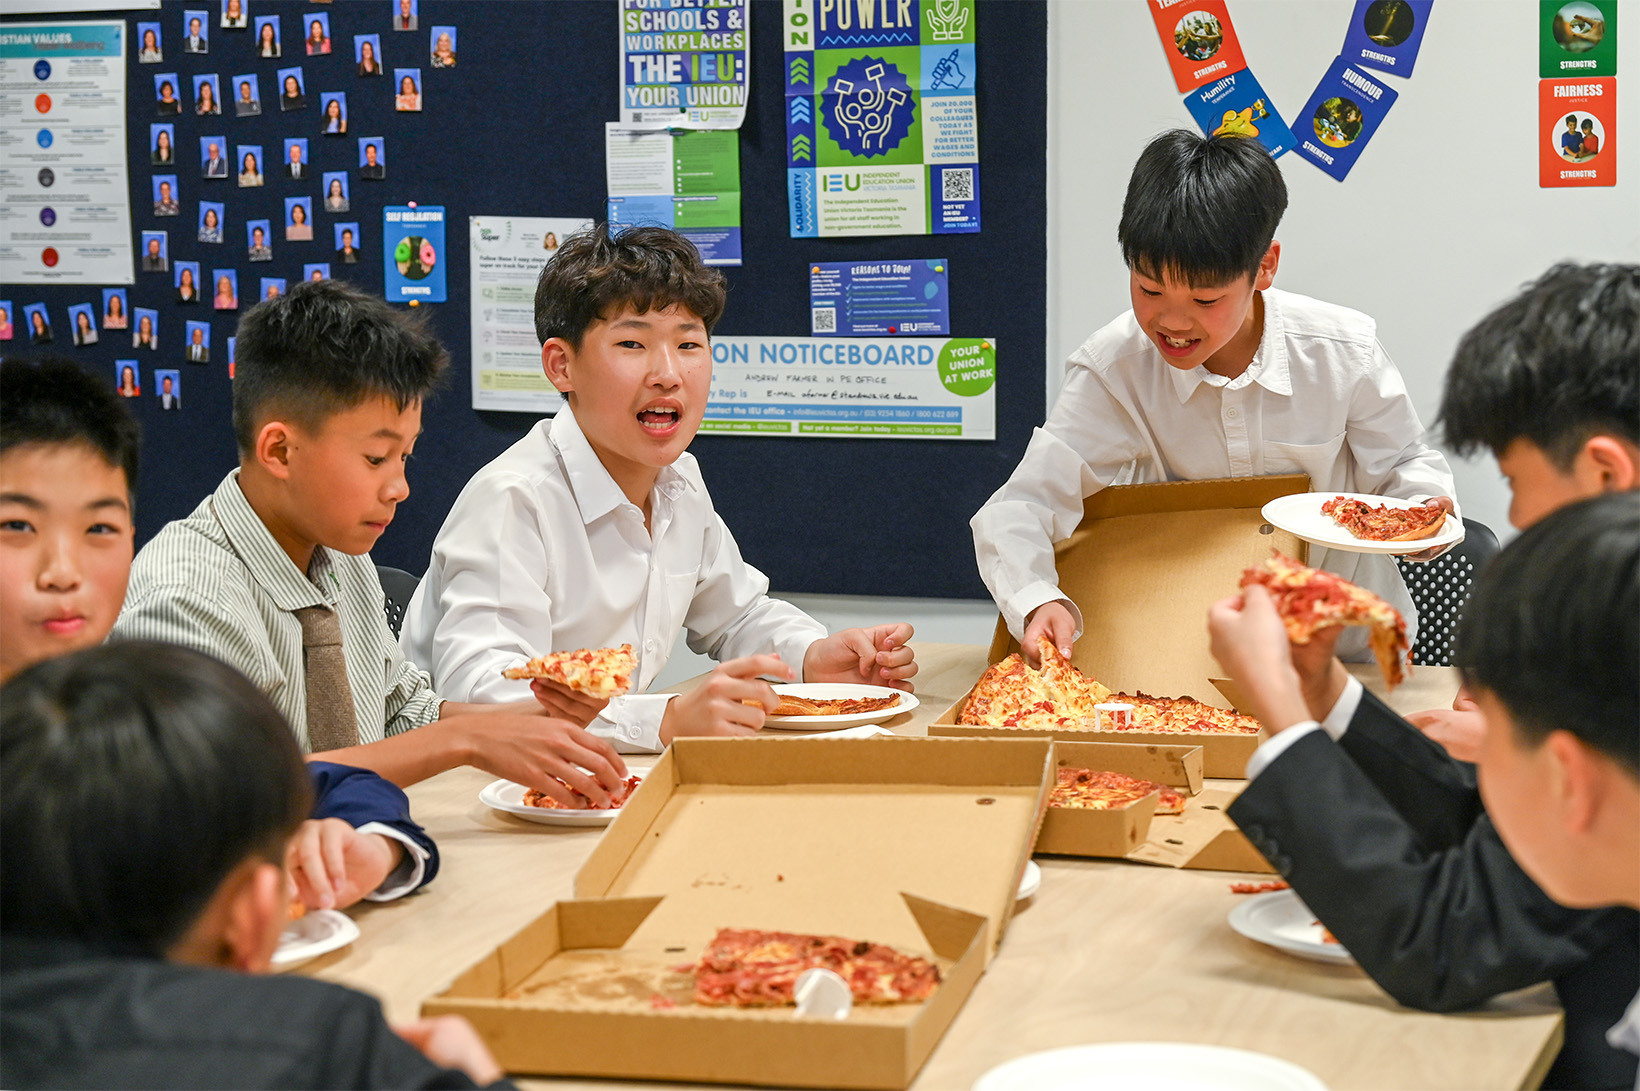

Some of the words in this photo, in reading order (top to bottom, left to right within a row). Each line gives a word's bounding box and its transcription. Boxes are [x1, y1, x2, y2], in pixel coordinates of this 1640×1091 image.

[626, 9, 720, 31] SCHOOLS
[727, 9, 743, 29] &
[32, 33, 73, 44] VALUES
[626, 33, 743, 51] WORKPLACES
[1361, 49, 1396, 66] STRENGTHS
[1560, 59, 1597, 70] STRENGTHS
[628, 54, 682, 83] THE
[691, 53, 743, 82] IEU:
[1193, 60, 1227, 79] STRENGTHS
[1200, 75, 1236, 102] Humility
[1342, 67, 1383, 100] HUMOUR
[1553, 84, 1603, 98] FAIRNESS
[626, 86, 680, 107] YOUR
[685, 85, 744, 106] UNION
[1211, 86, 1235, 104] TEMPERANCE
[1341, 80, 1374, 104] TRANSCENDENCE
[688, 111, 709, 122] IEU
[1302, 140, 1335, 166] STRENGTHS
[823, 173, 861, 192] IEU
[1560, 169, 1597, 180] STRENGTHS
[793, 173, 804, 233] SOLIDARITY
[385, 211, 401, 222] SELF
[851, 265, 880, 276] REASONS
[881, 265, 891, 274] TO
[900, 322, 918, 332] IEU
[712, 342, 749, 364] ON
[760, 342, 934, 366] NOTICEBOARD
[950, 345, 980, 358] YOUR
[949, 357, 985, 371] UNION
[745, 373, 779, 383] ANDREW
[855, 375, 887, 384] OFFICE
[944, 373, 958, 384] AT
[961, 368, 994, 382] WORK
[719, 389, 737, 399] Rep
[739, 389, 748, 398] is
[733, 406, 747, 415] the
[748, 407, 762, 415] IEU
[763, 407, 786, 416] office
[916, 410, 932, 418] 1800
